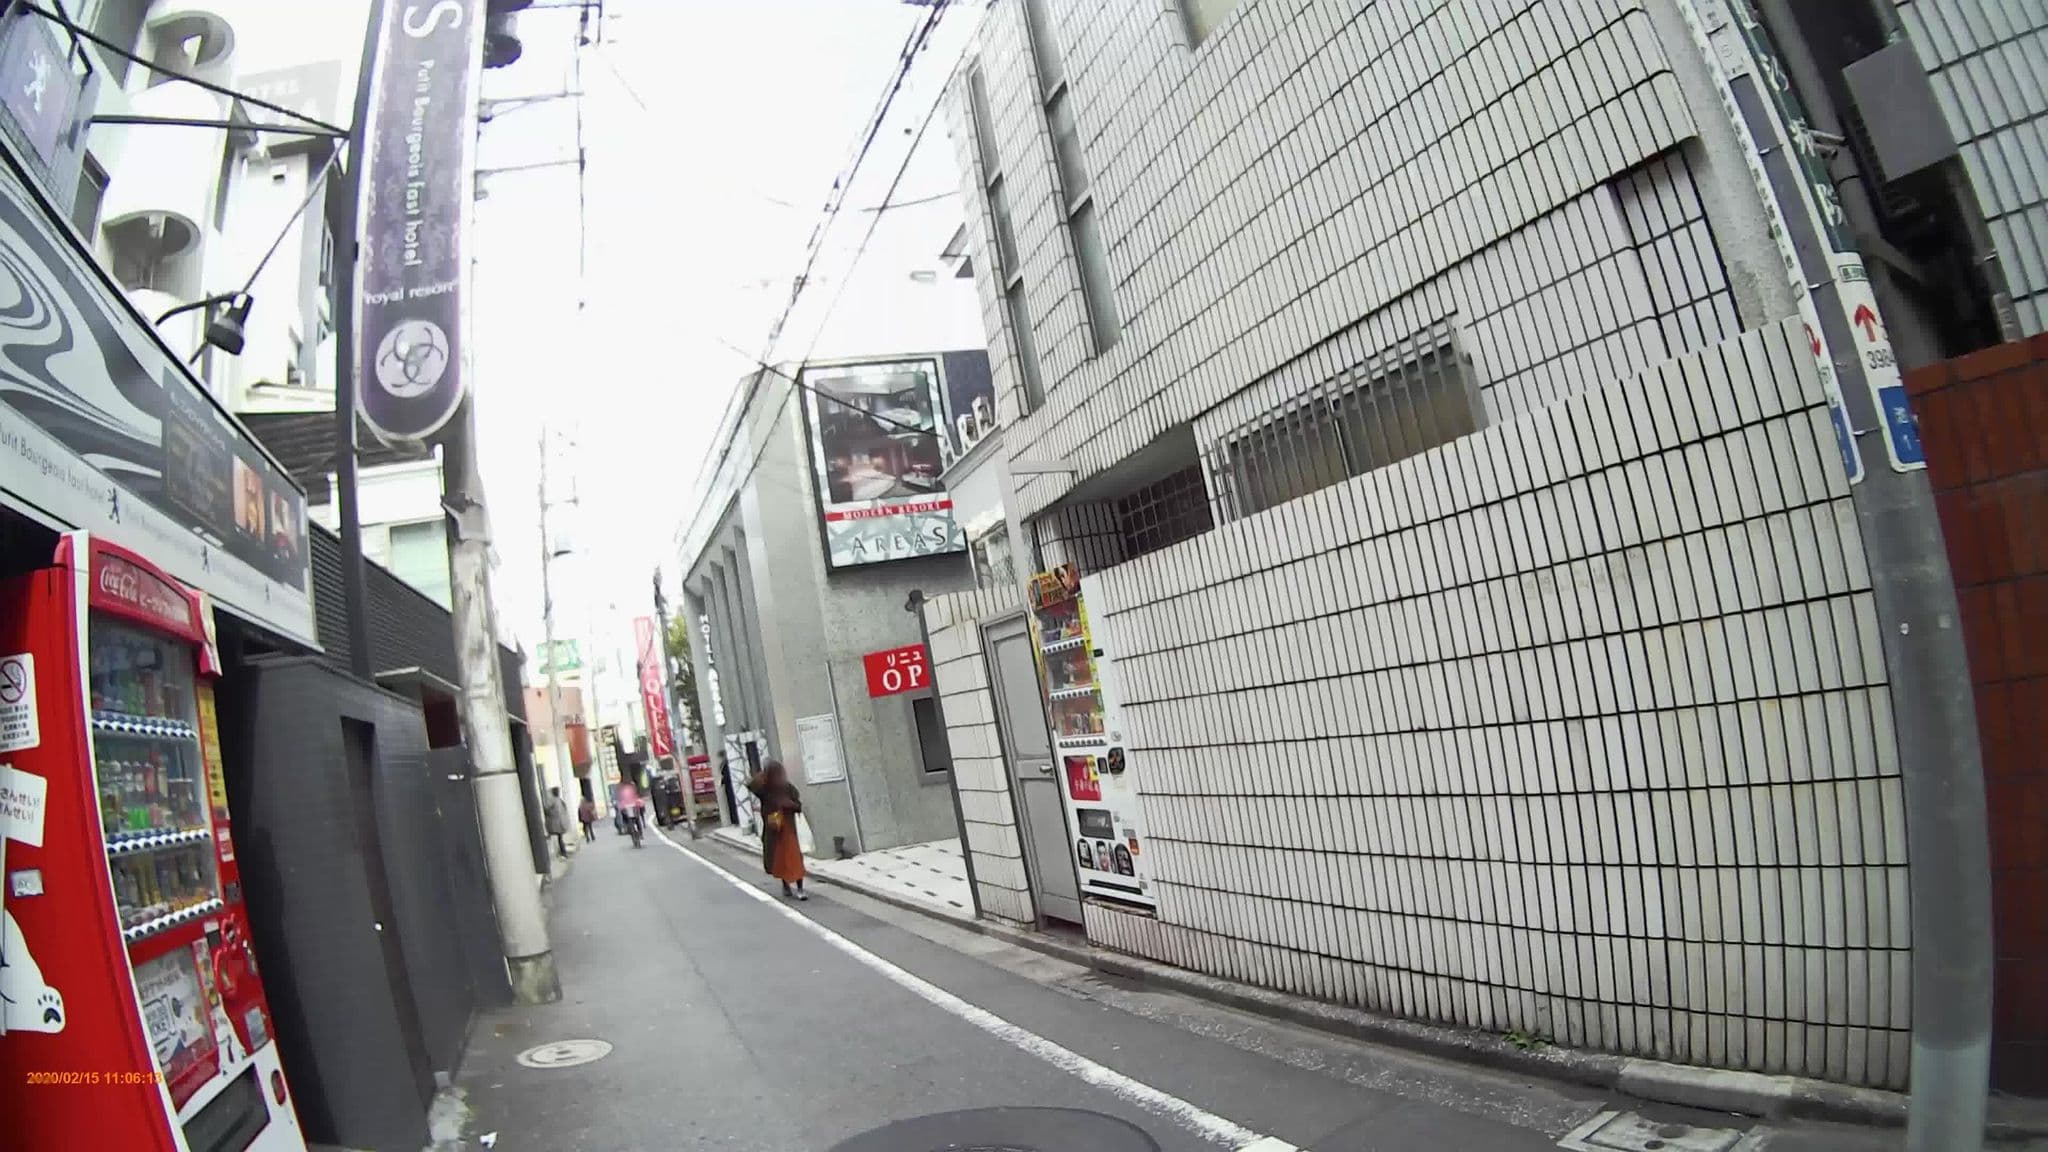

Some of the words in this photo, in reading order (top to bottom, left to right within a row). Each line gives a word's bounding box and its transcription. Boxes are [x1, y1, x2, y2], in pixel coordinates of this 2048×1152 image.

[406, 181, 425, 214] fast
[404, 219, 423, 266] hotel
[843, 505, 894, 521] MODERN
[897, 501, 941, 515] RESORT
[851, 526, 946, 556] AREAS
[882, 664, 922, 691] OP
